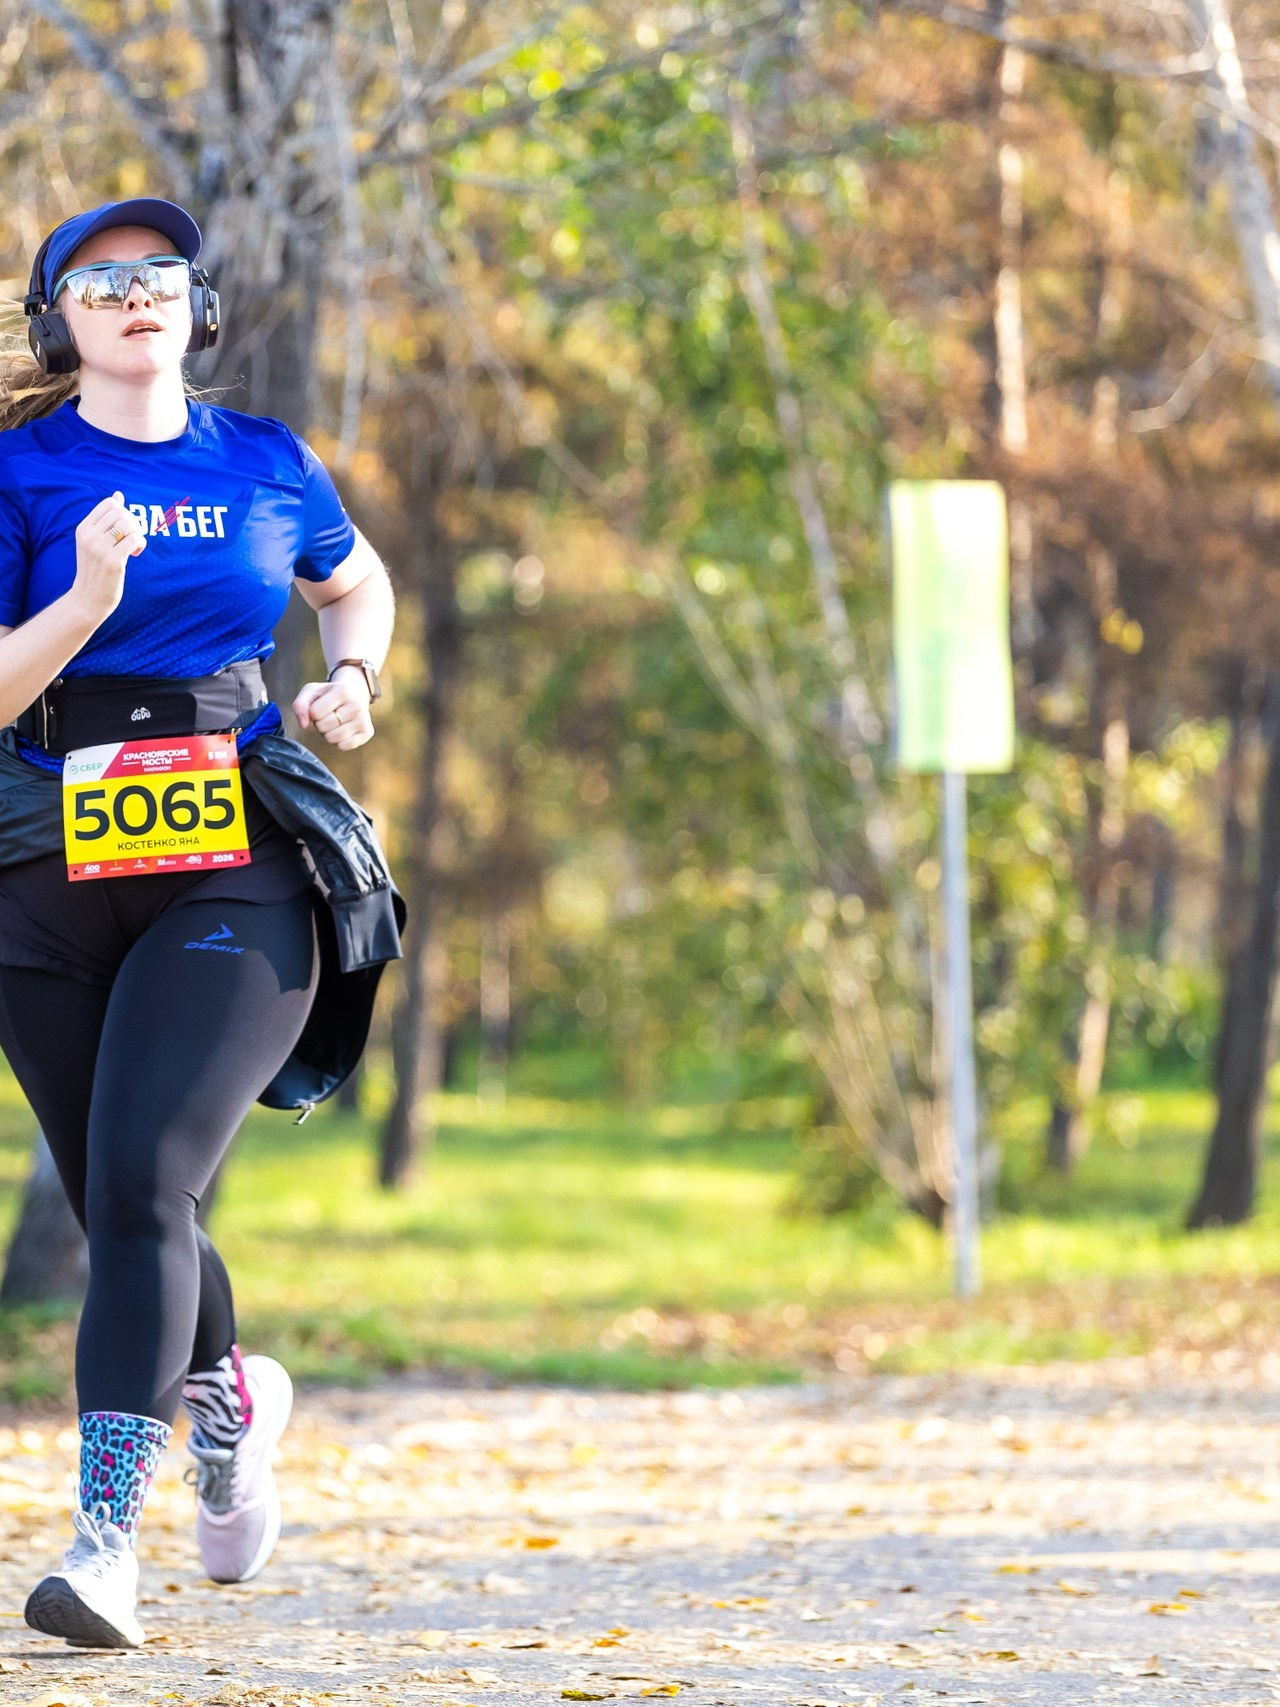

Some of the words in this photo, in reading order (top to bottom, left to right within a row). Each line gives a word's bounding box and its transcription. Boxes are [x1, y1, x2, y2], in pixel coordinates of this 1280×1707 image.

[123, 748, 189, 761] КРАСНОЯРСКИЕ
[80, 762, 103, 773] СБЕР
[142, 758, 173, 767] МОСТЫ
[74, 779, 235, 841] 5065
[117, 838, 177, 851] КОСТЕНКО
[178, 836, 200, 846] ЯНА
[183, 942, 246, 955] DEMIX
